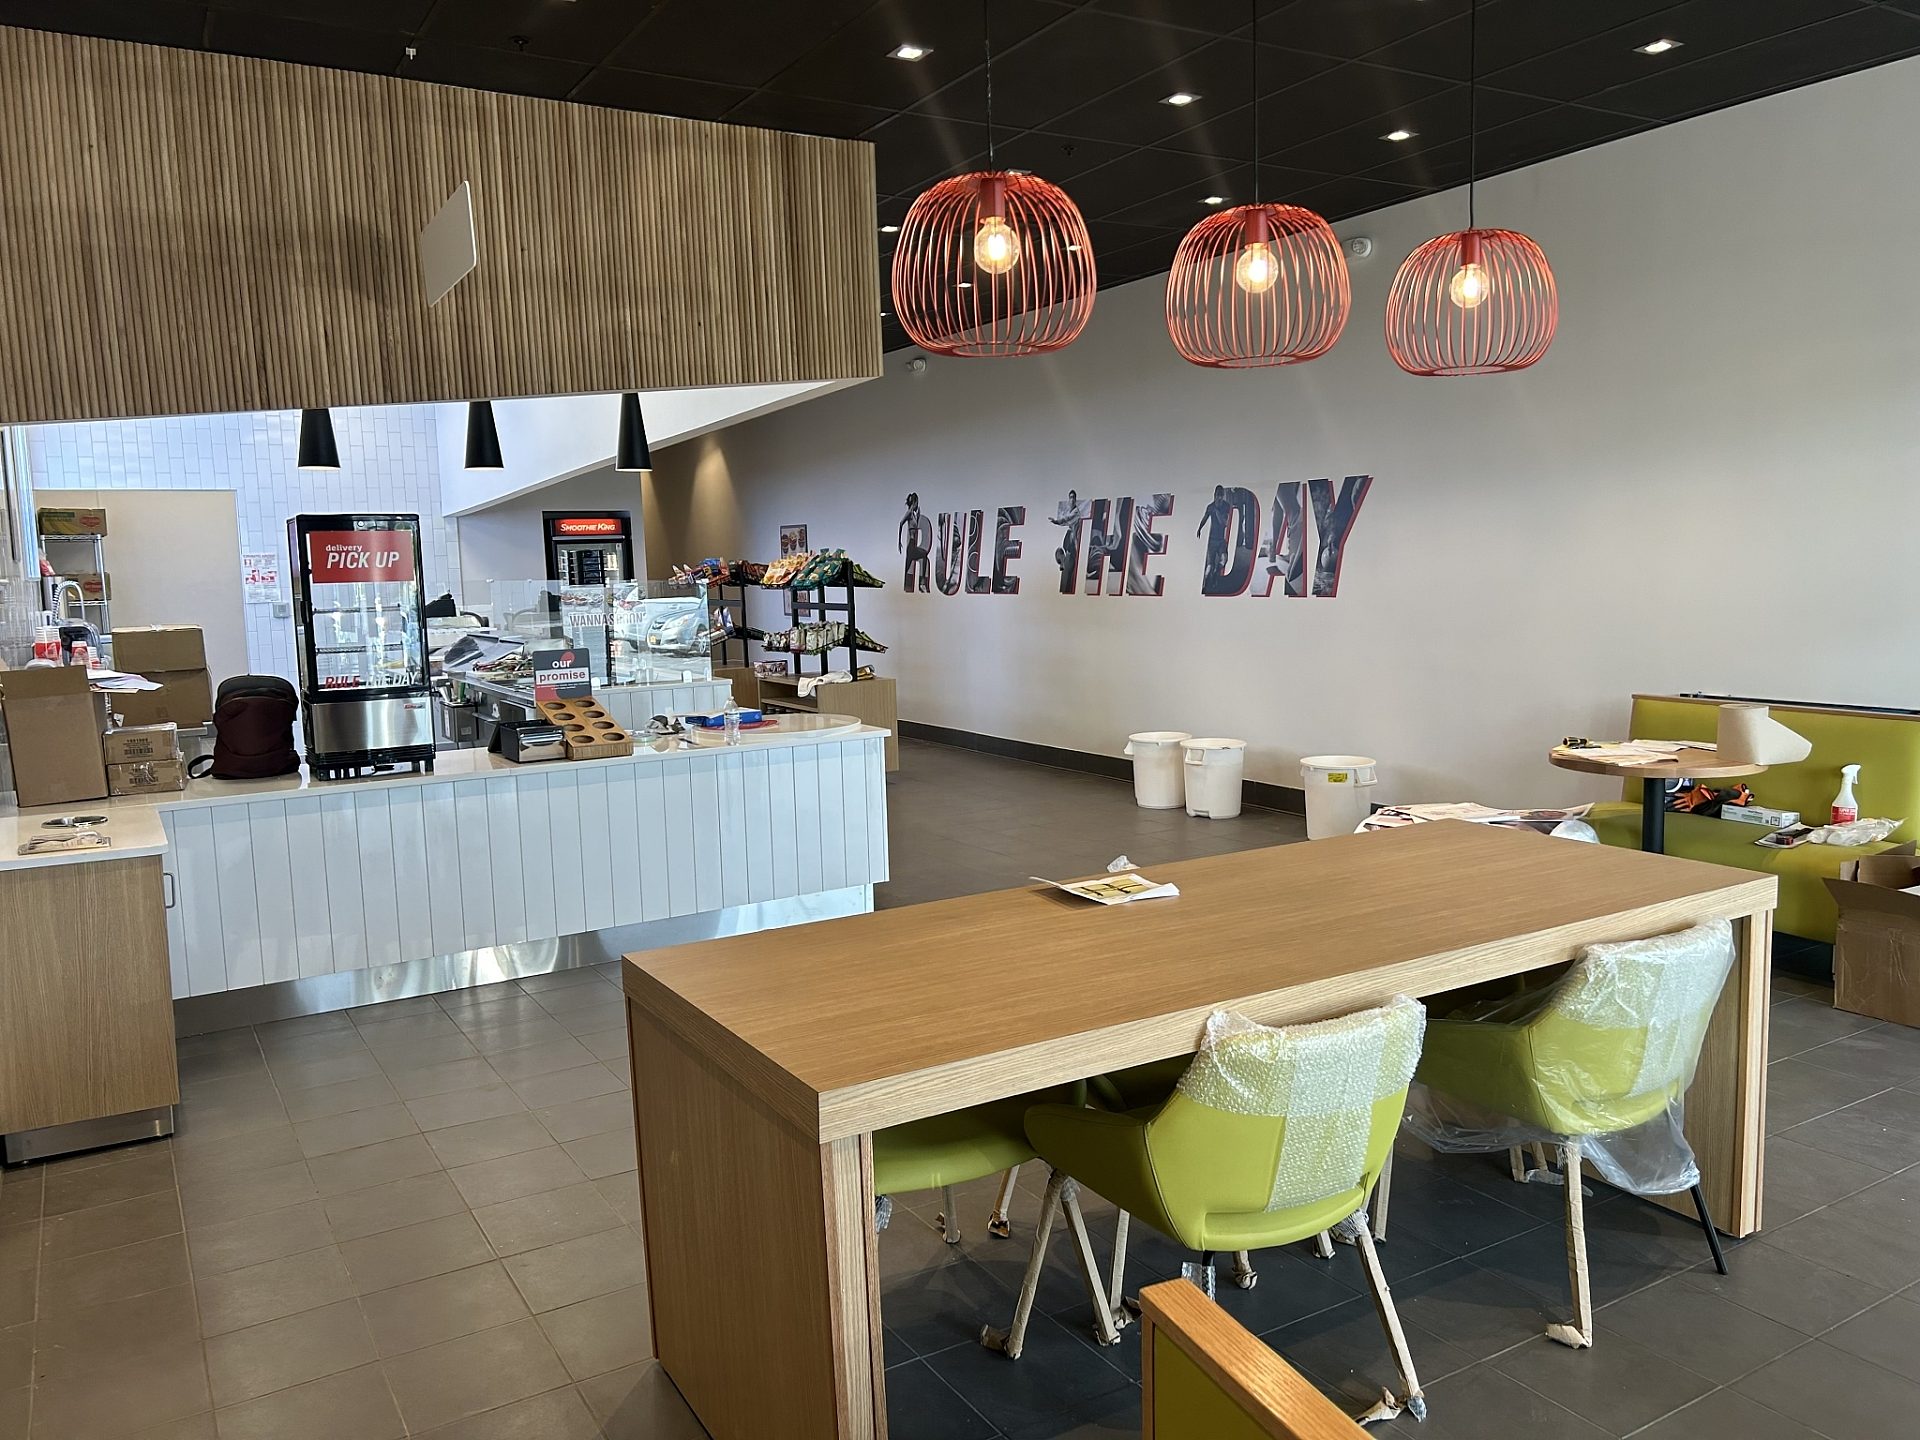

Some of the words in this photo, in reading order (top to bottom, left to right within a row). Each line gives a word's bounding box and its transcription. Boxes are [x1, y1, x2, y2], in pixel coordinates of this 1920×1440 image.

[560, 523, 597, 532] SMOOTHIE
[597, 523, 616, 531] KING
[900, 504, 1026, 596] RULE
[1056, 493, 1175, 596] THE
[1200, 475, 1374, 598] DAY
[325, 544, 363, 552] delivery
[326, 551, 371, 569] PICK
[375, 551, 400, 568] UP
[569, 613, 608, 628] WANNA
[552, 659, 572, 668] our
[325, 675, 361, 689] RULE
[392, 671, 418, 687] DAY
[539, 670, 586, 684] promise
